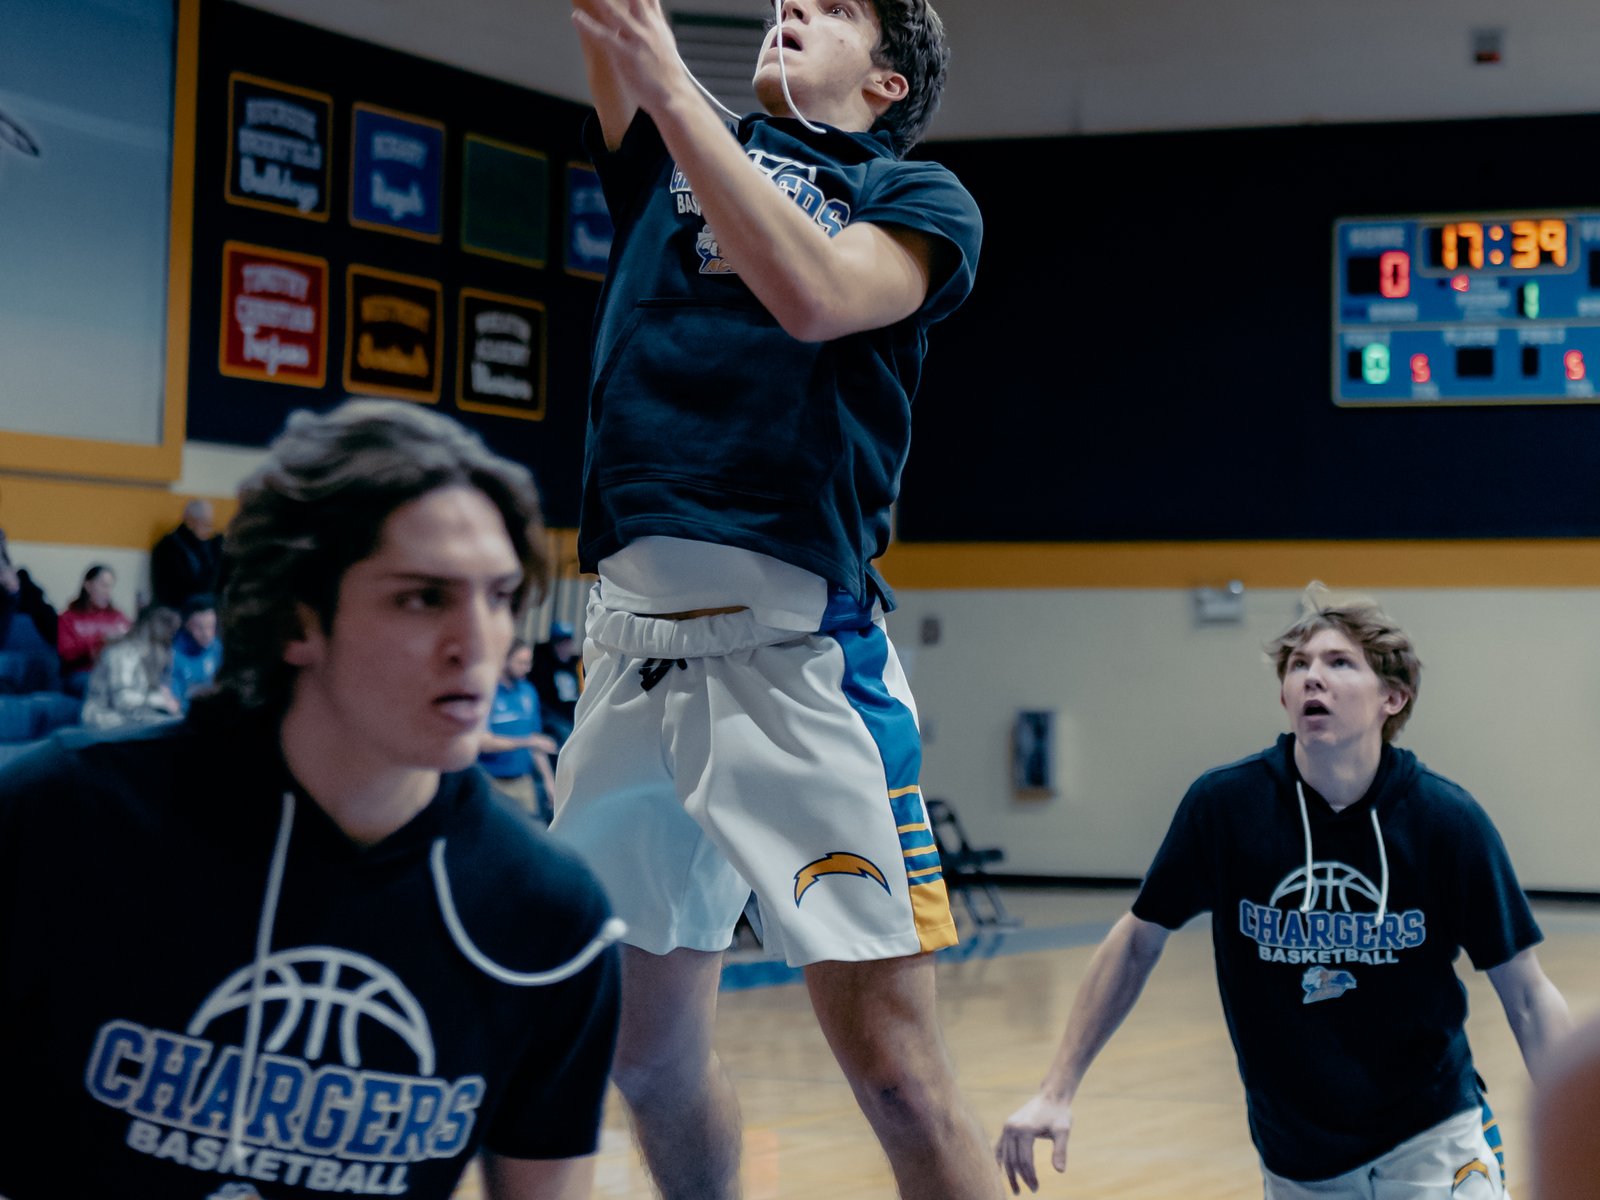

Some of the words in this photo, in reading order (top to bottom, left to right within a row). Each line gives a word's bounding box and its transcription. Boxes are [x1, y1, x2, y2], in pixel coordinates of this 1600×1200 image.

[1441, 219, 1568, 270] 17:39
[1380, 250, 1410, 298] 0
[1240, 898, 1427, 951] CHARGERS
[1258, 945, 1400, 965] BASKETBALL
[85, 1019, 487, 1163] CHARGERS
[126, 1118, 410, 1195] BASKETBALL
